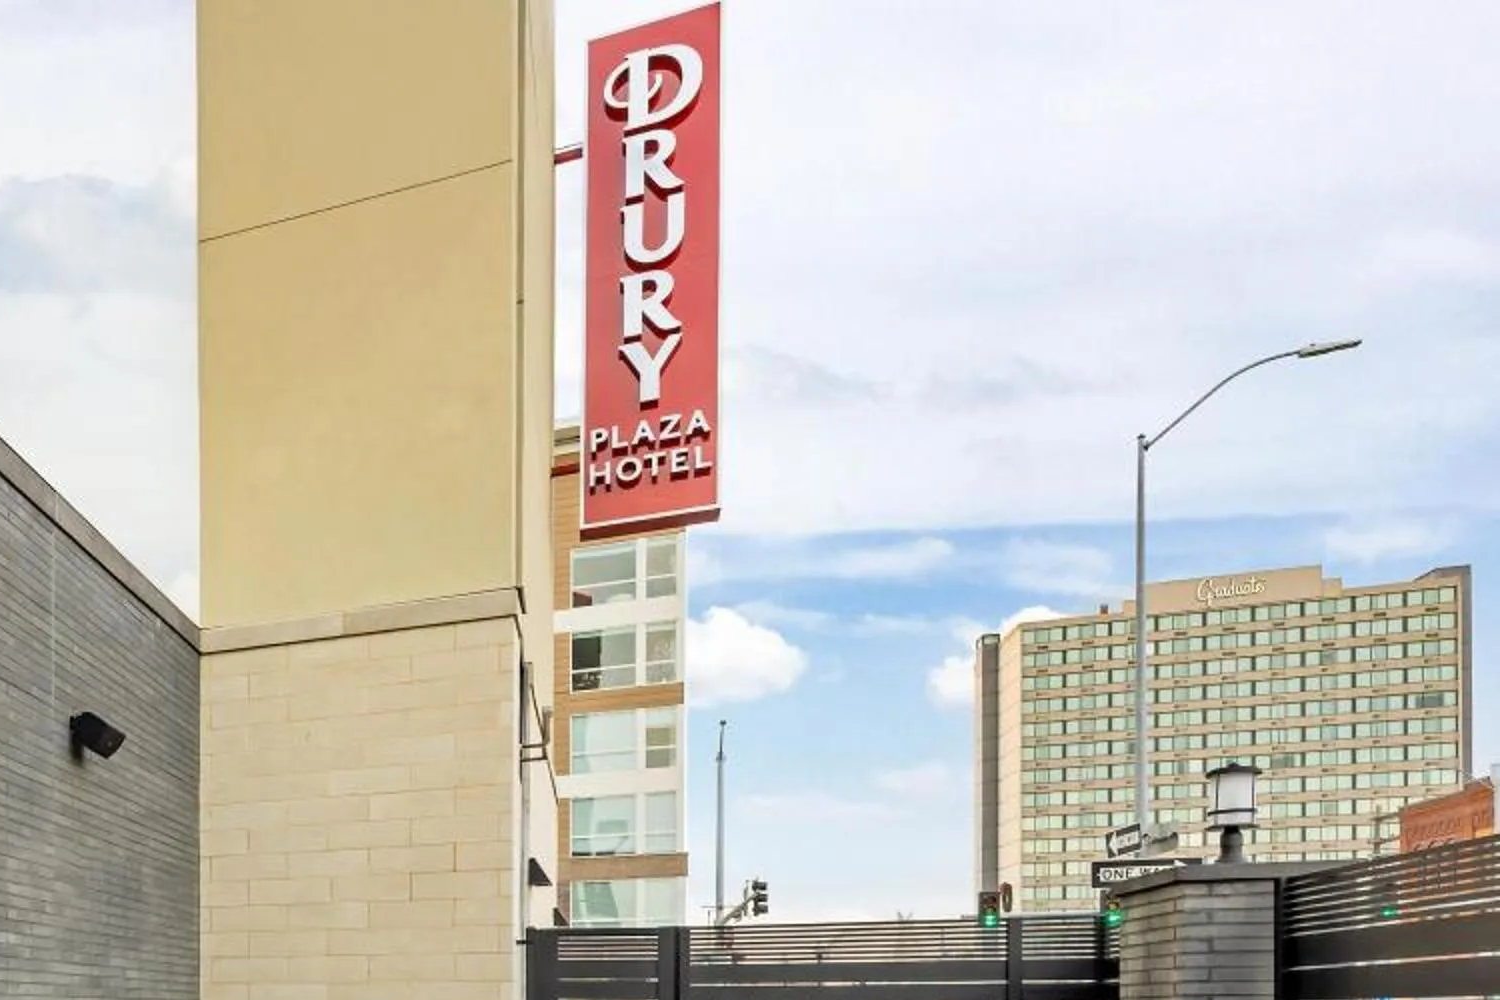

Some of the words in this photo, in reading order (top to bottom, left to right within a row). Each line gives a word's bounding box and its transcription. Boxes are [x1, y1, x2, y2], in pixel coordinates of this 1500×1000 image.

[603, 43, 703, 404] DRURY
[589, 409, 711, 453] PLAZA
[589, 446, 713, 487] HOTEL
